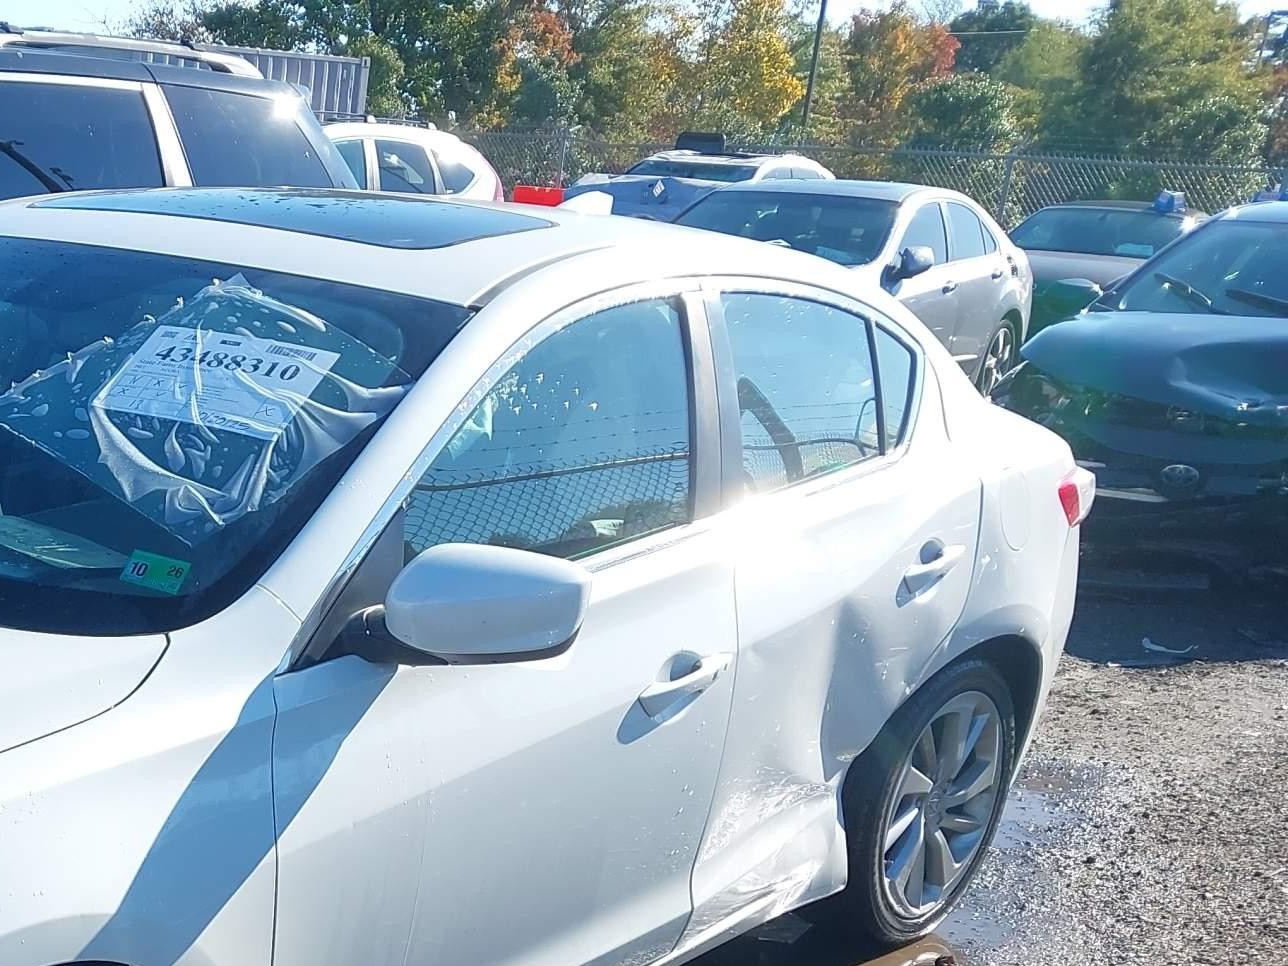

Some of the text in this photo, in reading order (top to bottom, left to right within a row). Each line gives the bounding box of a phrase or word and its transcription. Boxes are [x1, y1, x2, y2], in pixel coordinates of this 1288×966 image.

[155, 345, 302, 382] 43488310
[198, 410, 250, 431] 0/20/25
[130, 561, 185, 579] 10 26
